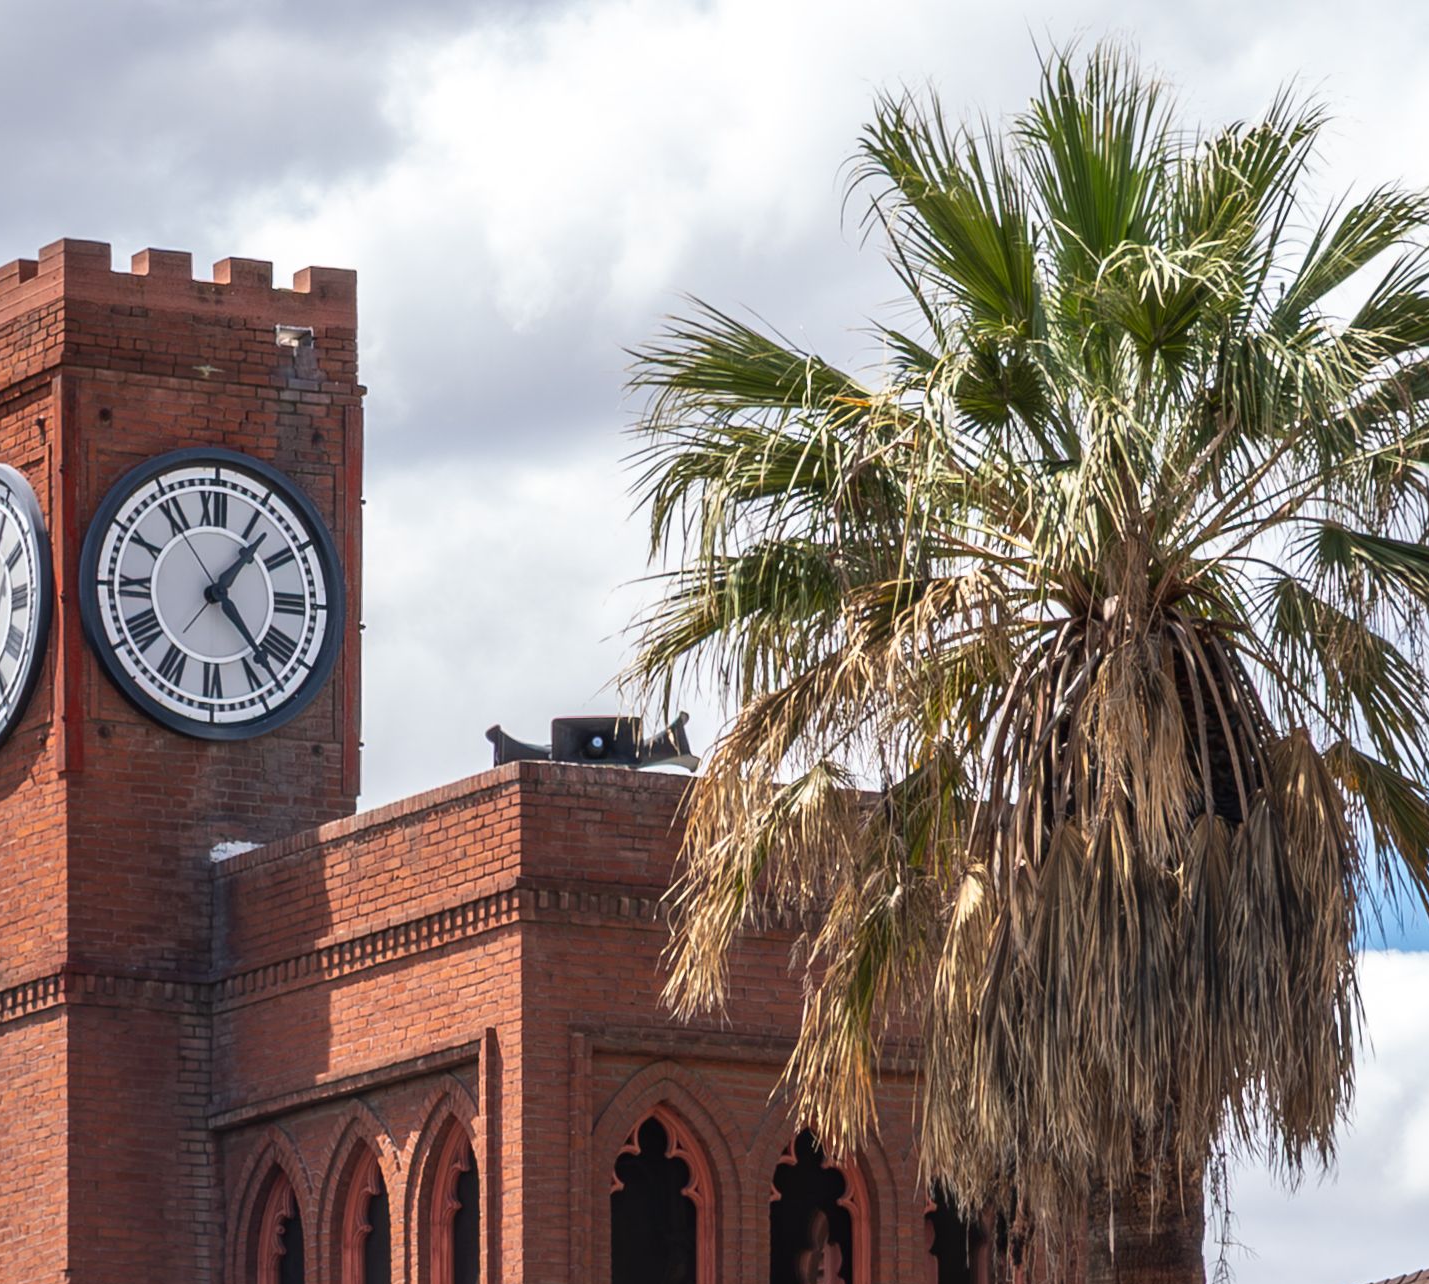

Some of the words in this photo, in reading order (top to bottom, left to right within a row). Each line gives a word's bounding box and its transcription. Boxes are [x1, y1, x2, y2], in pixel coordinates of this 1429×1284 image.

[200, 490, 228, 529] XII
[273, 591, 306, 616] III
[202, 662, 223, 699] VI
